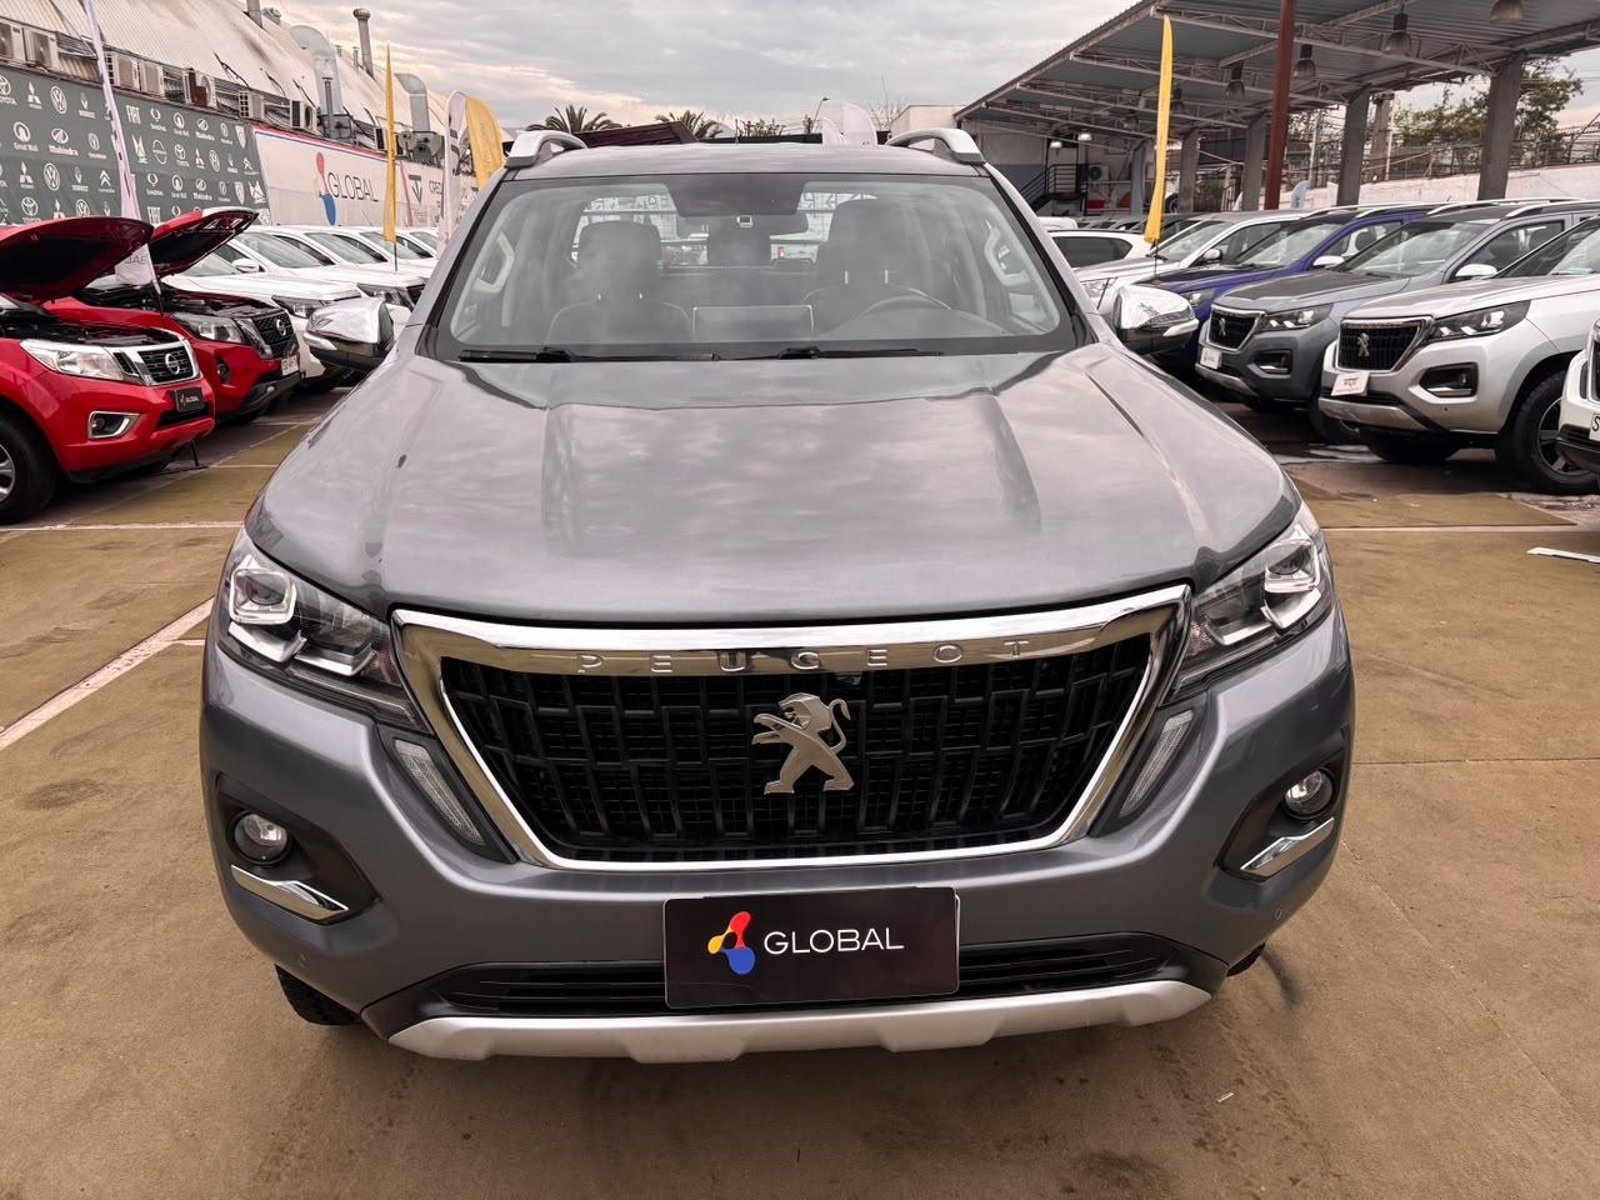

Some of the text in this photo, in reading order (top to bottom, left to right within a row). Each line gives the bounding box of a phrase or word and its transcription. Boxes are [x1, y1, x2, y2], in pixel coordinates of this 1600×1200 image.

[328, 172, 378, 202] GLOBAL
[577, 640, 1030, 673] PEUGEOT
[763, 927, 905, 955] GLOBAL
